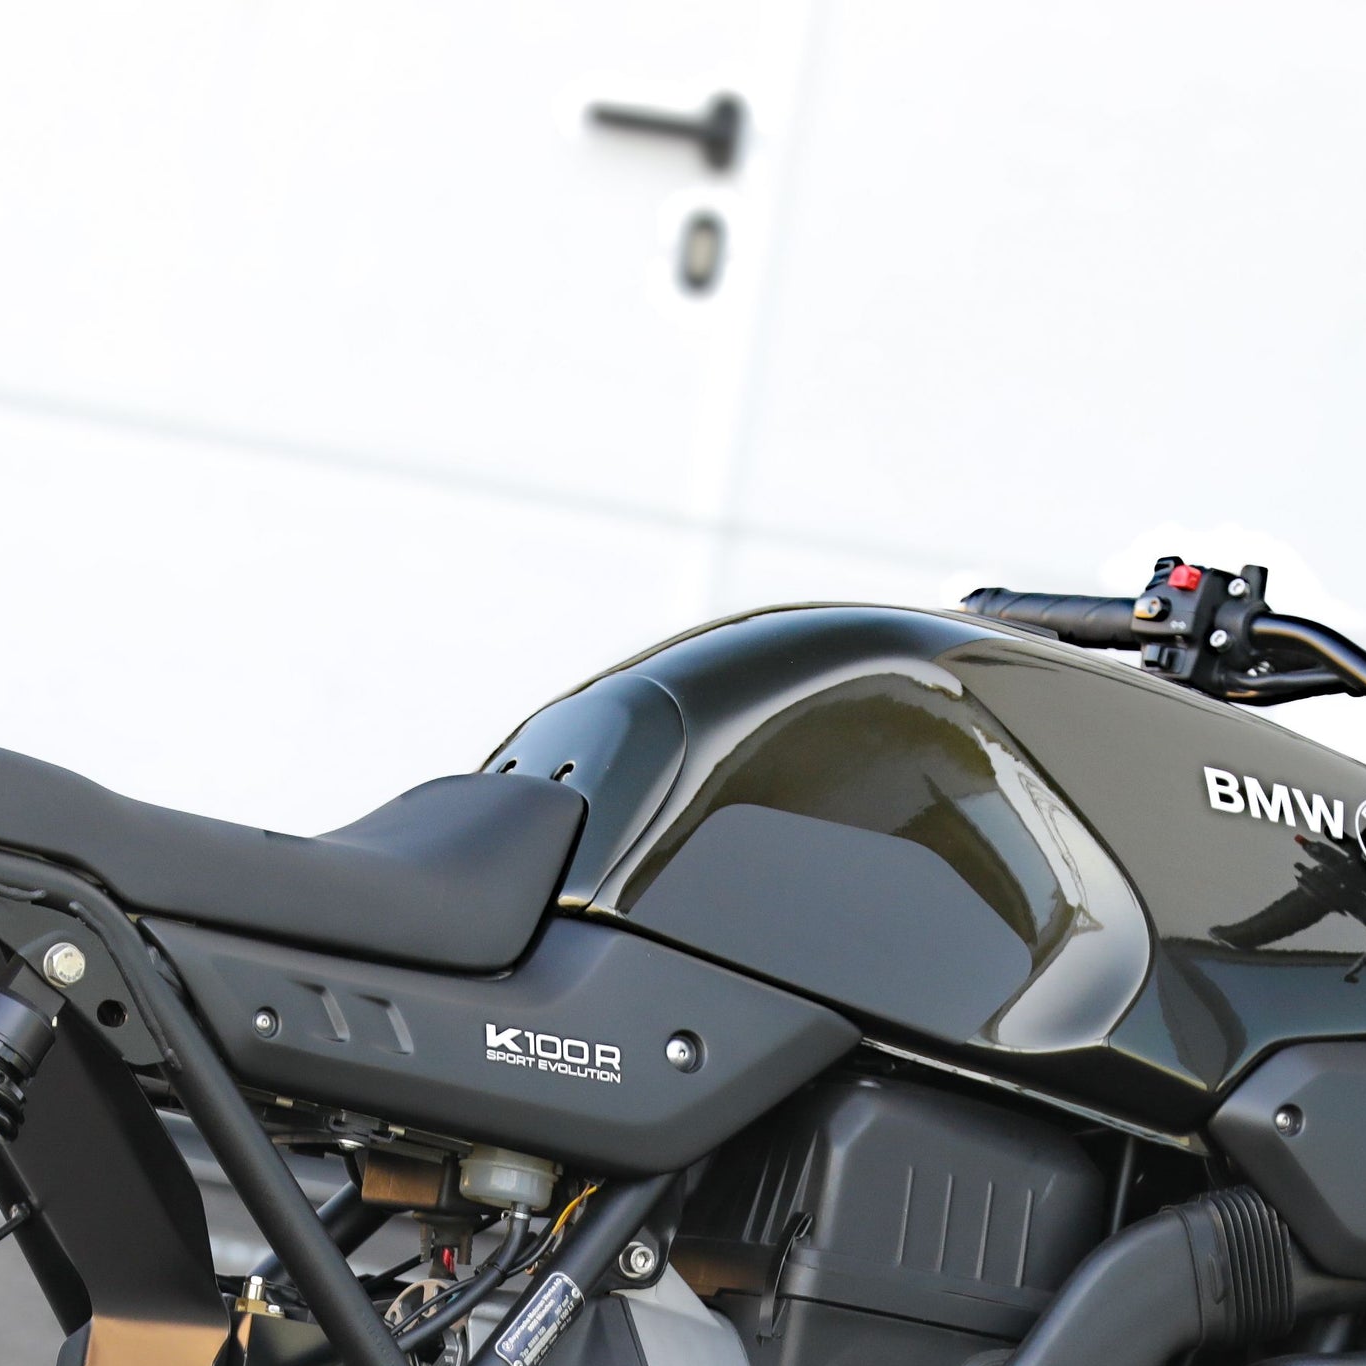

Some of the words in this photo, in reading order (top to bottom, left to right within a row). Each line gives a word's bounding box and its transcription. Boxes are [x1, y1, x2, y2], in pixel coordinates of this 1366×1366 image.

[1204, 766, 1344, 839] BMW
[486, 1049, 536, 1068] SPORT
[538, 1058, 621, 1084] EVOLUTION
